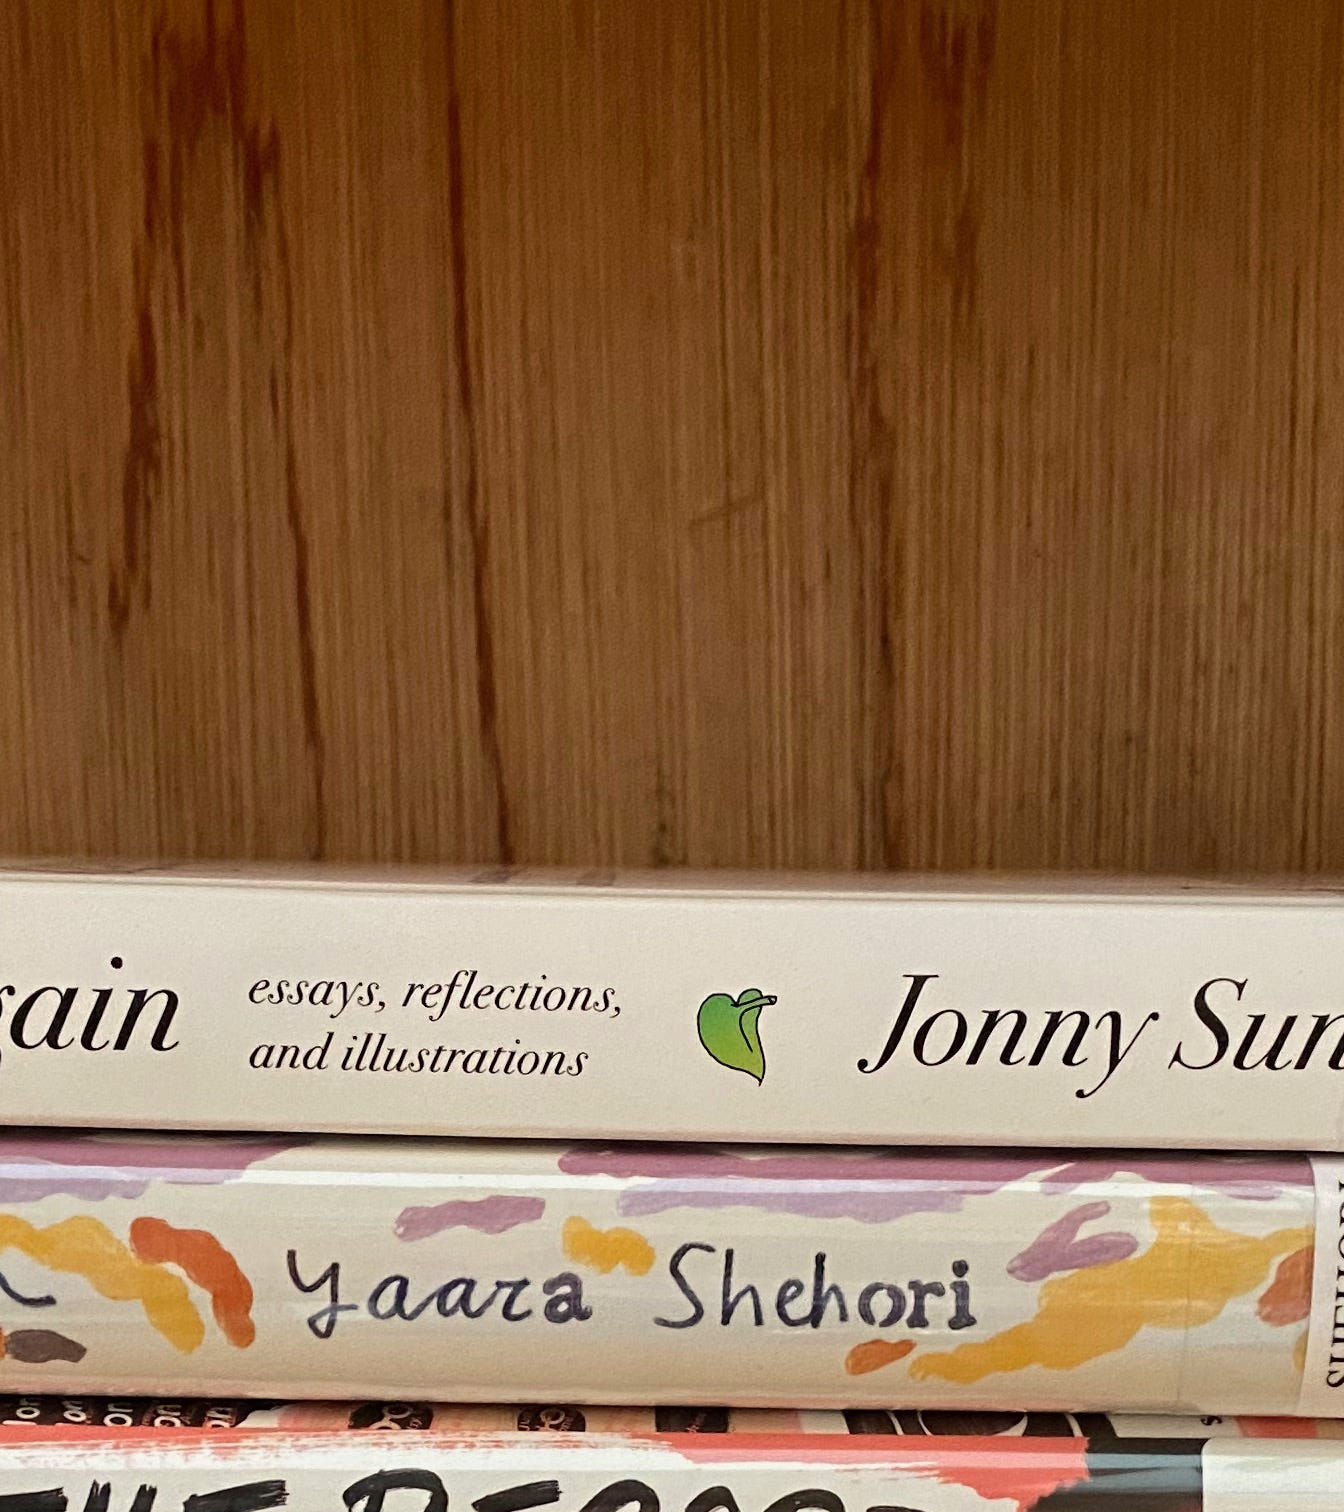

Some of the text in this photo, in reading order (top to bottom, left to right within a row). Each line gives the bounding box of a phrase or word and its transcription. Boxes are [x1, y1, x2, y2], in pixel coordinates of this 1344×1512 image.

[248, 971, 623, 1021] essays, reflections,
[249, 1033, 588, 1077] and illustrations
[857, 974, 1158, 1098] Jonny
[654, 1241, 978, 1331] Shehori
